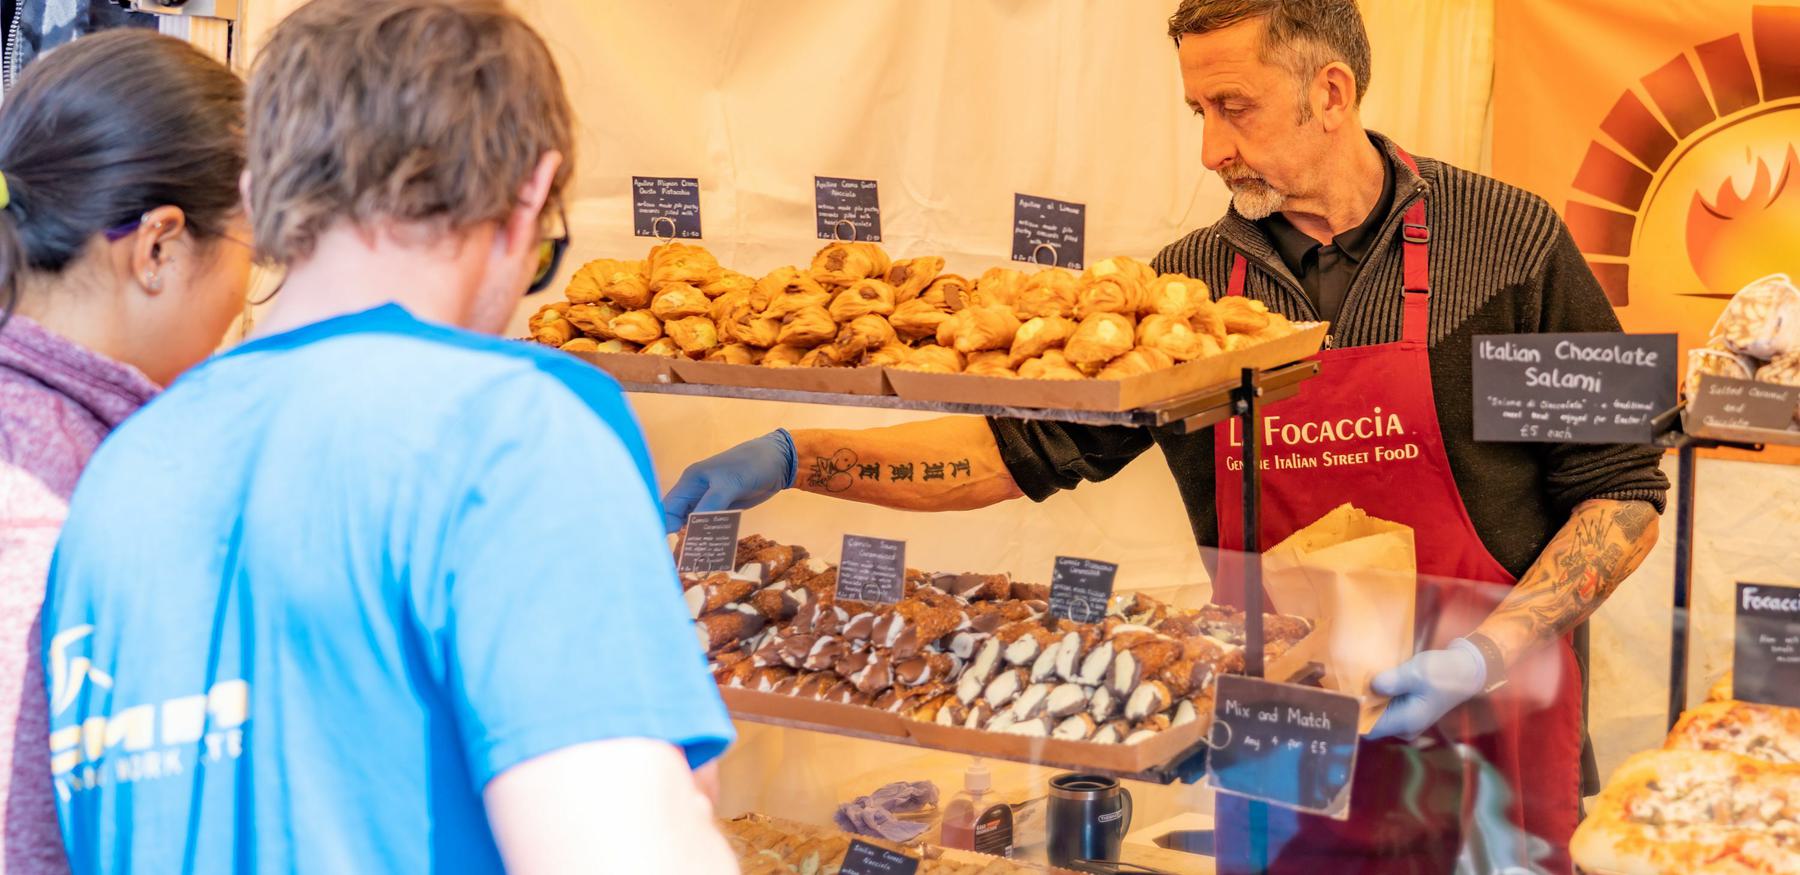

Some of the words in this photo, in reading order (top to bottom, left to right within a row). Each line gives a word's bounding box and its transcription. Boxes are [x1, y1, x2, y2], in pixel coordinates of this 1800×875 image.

[1479, 340, 1541, 363] Italian
[1554, 340, 1658, 367] Chocolate
[1524, 366, 1603, 393] Salami
[1723, 403, 1745, 413] and
[1230, 417, 1245, 447] L
[1519, 423, 1539, 437] £5
[1547, 426, 1573, 439] each
[1225, 699, 1250, 718] Mix
[1258, 706, 1279, 722] and
[1287, 707, 1331, 730] Match
[1271, 735, 1279, 745] 4
[1310, 739, 1328, 755] £5
